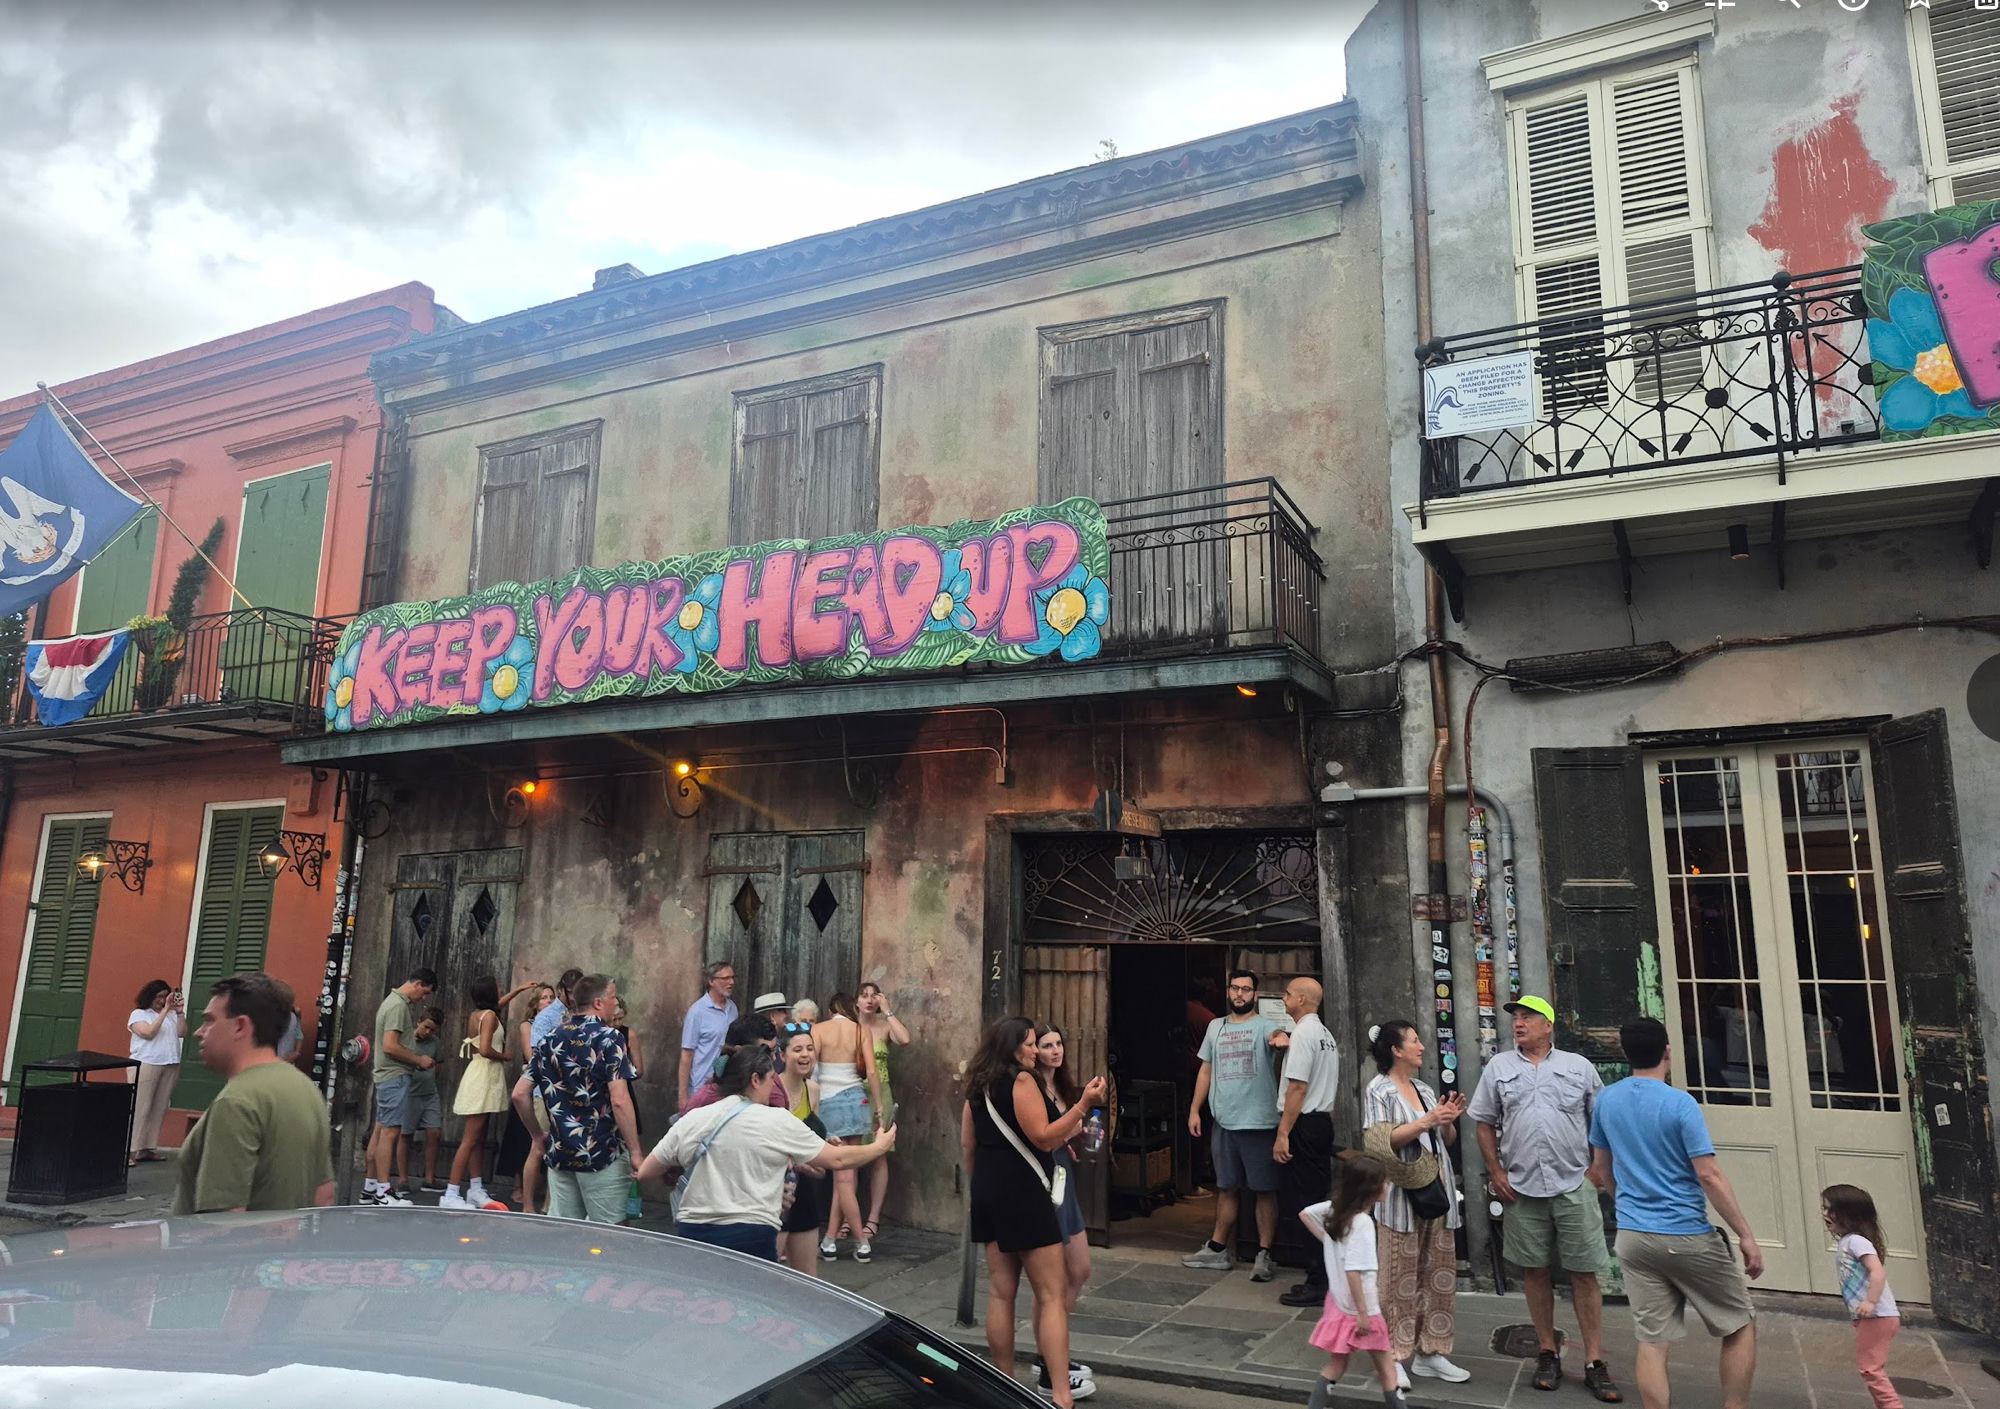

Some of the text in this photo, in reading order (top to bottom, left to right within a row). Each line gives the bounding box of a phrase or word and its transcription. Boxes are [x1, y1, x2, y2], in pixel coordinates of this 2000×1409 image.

[1467, 365, 1511, 376] APPLICATION
[1513, 361, 1528, 369] HAS
[1458, 374, 1526, 389] CHANGE AFFECTING
[1461, 375, 1479, 383] BEEN
[1480, 372, 1500, 380] FILED
[1480, 381, 1522, 392] PROPERTY'S
[1478, 390, 1507, 398] ZONING.
[350, 520, 1080, 728] KEEP YOUR HEAD UP
